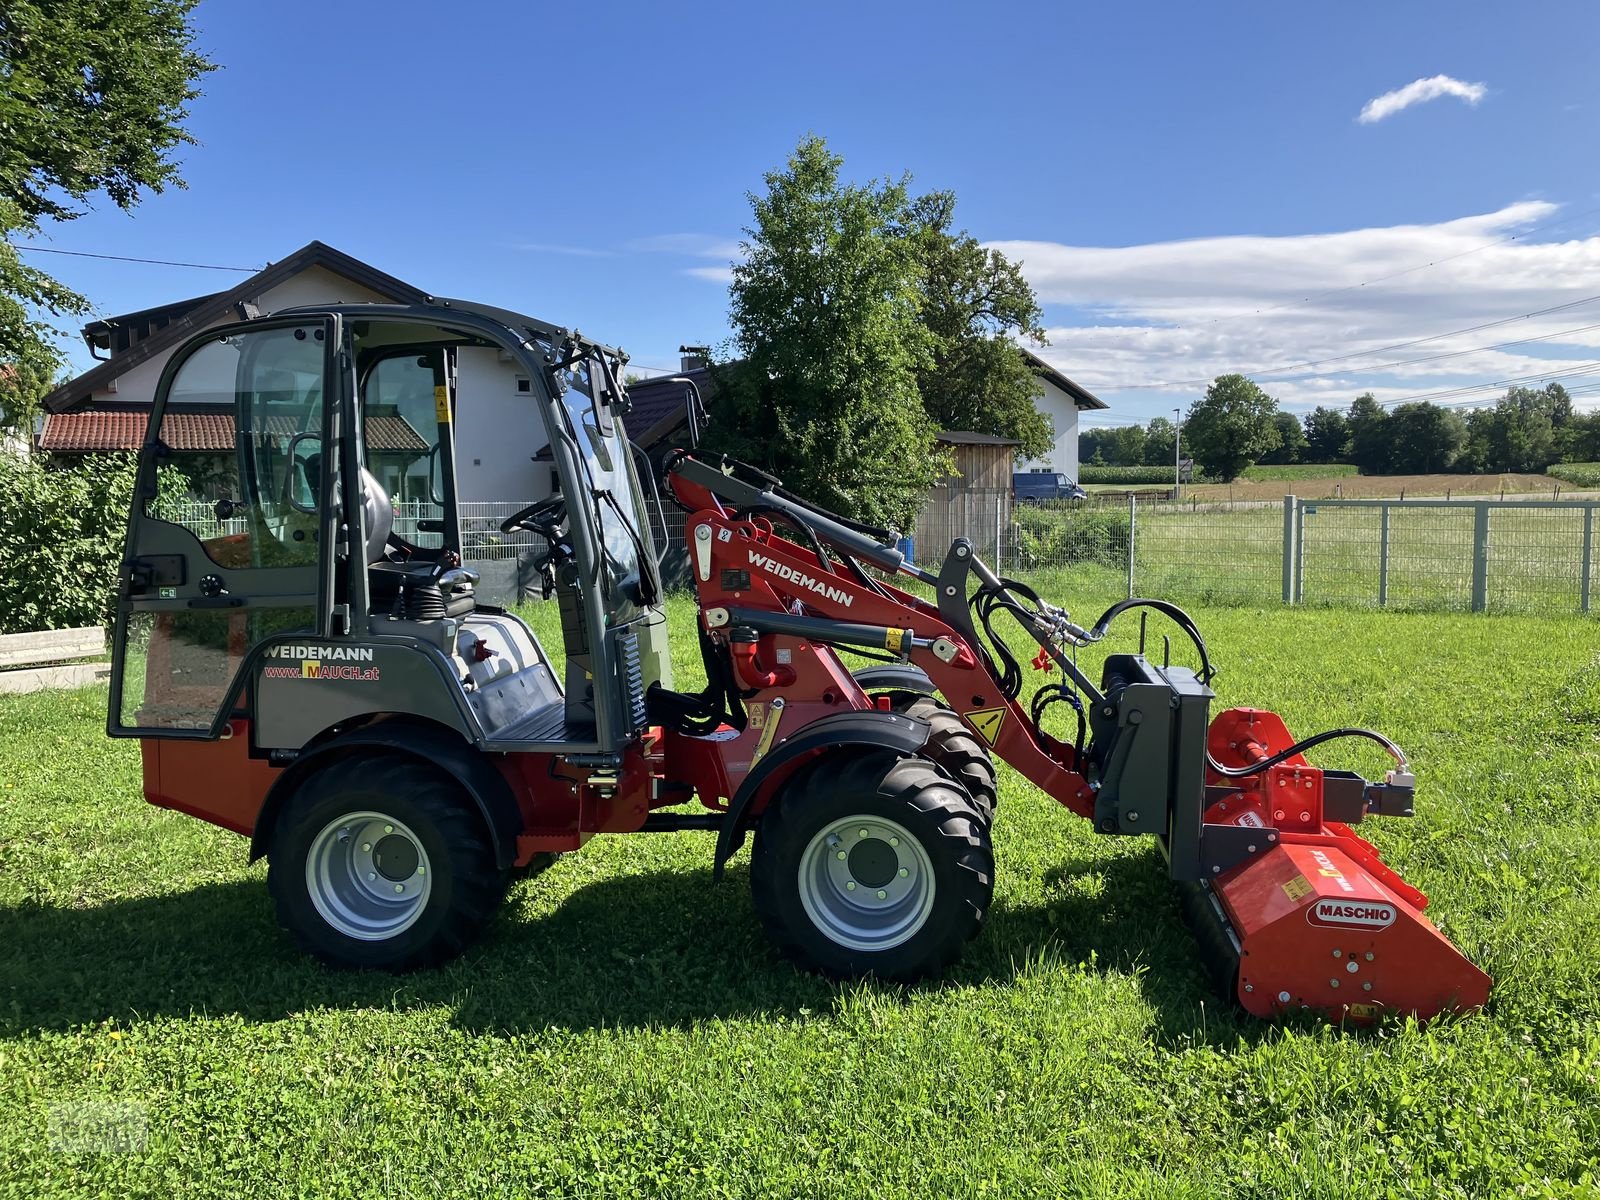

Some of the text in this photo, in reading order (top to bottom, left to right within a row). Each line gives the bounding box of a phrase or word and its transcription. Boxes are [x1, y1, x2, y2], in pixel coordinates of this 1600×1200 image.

[748, 549, 854, 608] WEIDEMANN
[265, 665, 379, 680] www.MAUCH.at
[1319, 904, 1391, 921] MASCHIO
